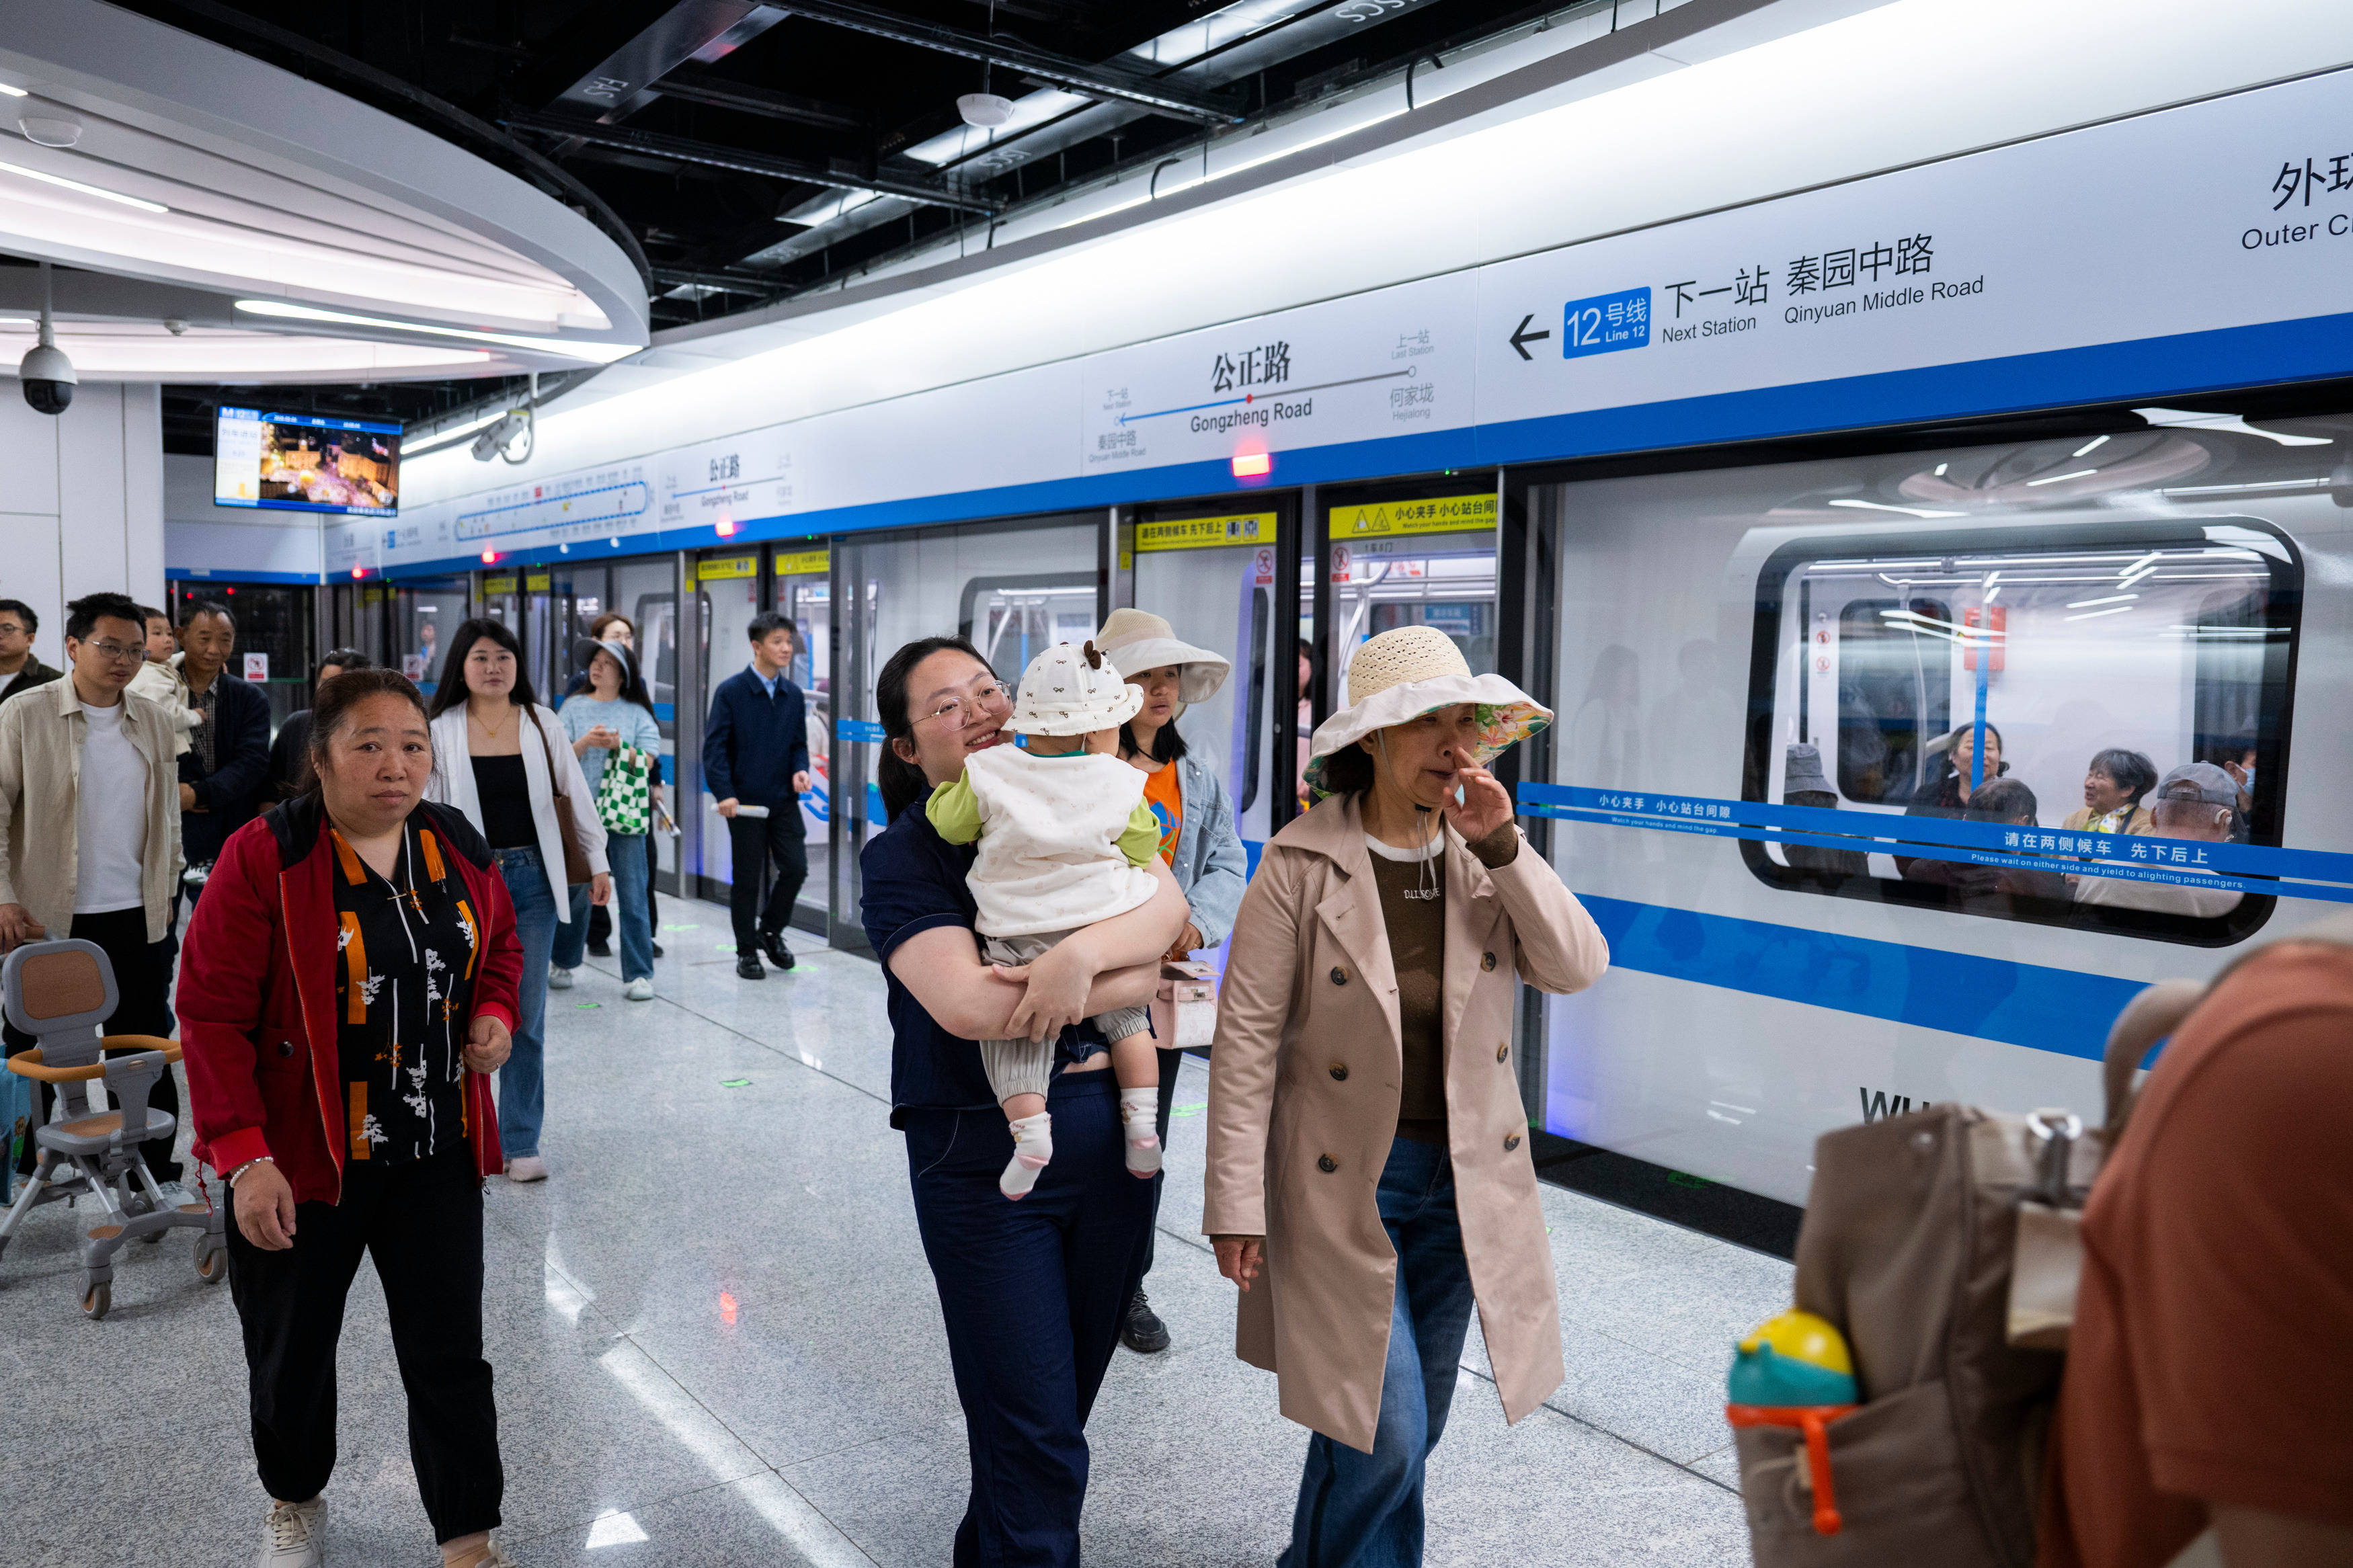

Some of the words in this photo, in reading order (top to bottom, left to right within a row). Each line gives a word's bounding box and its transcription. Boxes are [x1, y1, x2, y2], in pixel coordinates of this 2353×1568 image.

[1334, 0, 1417, 22] SCS
[584, 77, 629, 98] FAS
[2241, 223, 2319, 249] Outer
[2328, 214, 2353, 236] C
[1665, 265, 1770, 319] 下一站
[1786, 233, 1934, 296] 秦园中路
[1567, 307, 1601, 347] 12
[1605, 298, 1647, 327] 号线
[1663, 325, 1697, 343] Next
[1702, 317, 1757, 337] Station
[1784, 300, 1856, 324] Qinyuan
[1863, 287, 1925, 312] Middle
[1931, 275, 1984, 300] Road
[1396, 329, 1431, 349] 上一站
[1605, 330, 1629, 343] Line
[1632, 325, 1645, 337] 12
[1392, 350, 1407, 360] Last
[1408, 345, 1435, 357] Station
[1211, 341, 1291, 393] 公正路
[1390, 382, 1435, 409] 何家垅
[1191, 408, 1269, 434] Gongzheng
[1274, 398, 1313, 421] Road
[1392, 408, 1431, 422] Hejialong
[1395, 504, 1436, 520] 小心夹手
[1599, 794, 1644, 811] 小心夹手
[1656, 800, 1731, 819] 小心站台间隙
[2004, 831, 2112, 856] 请在两侧候车
[2130, 843, 2208, 864] 先下后上
[1971, 854, 1999, 864] Please
[2001, 856, 2019, 866] wait
[2033, 860, 2059, 870] either
[2061, 863, 2080, 872] side
[2082, 865, 2100, 874] and
[2102, 867, 2124, 876] yield
[2126, 870, 2136, 878] to
[2138, 871, 2182, 884] alighting
[2184, 876, 2247, 889] passengers.
